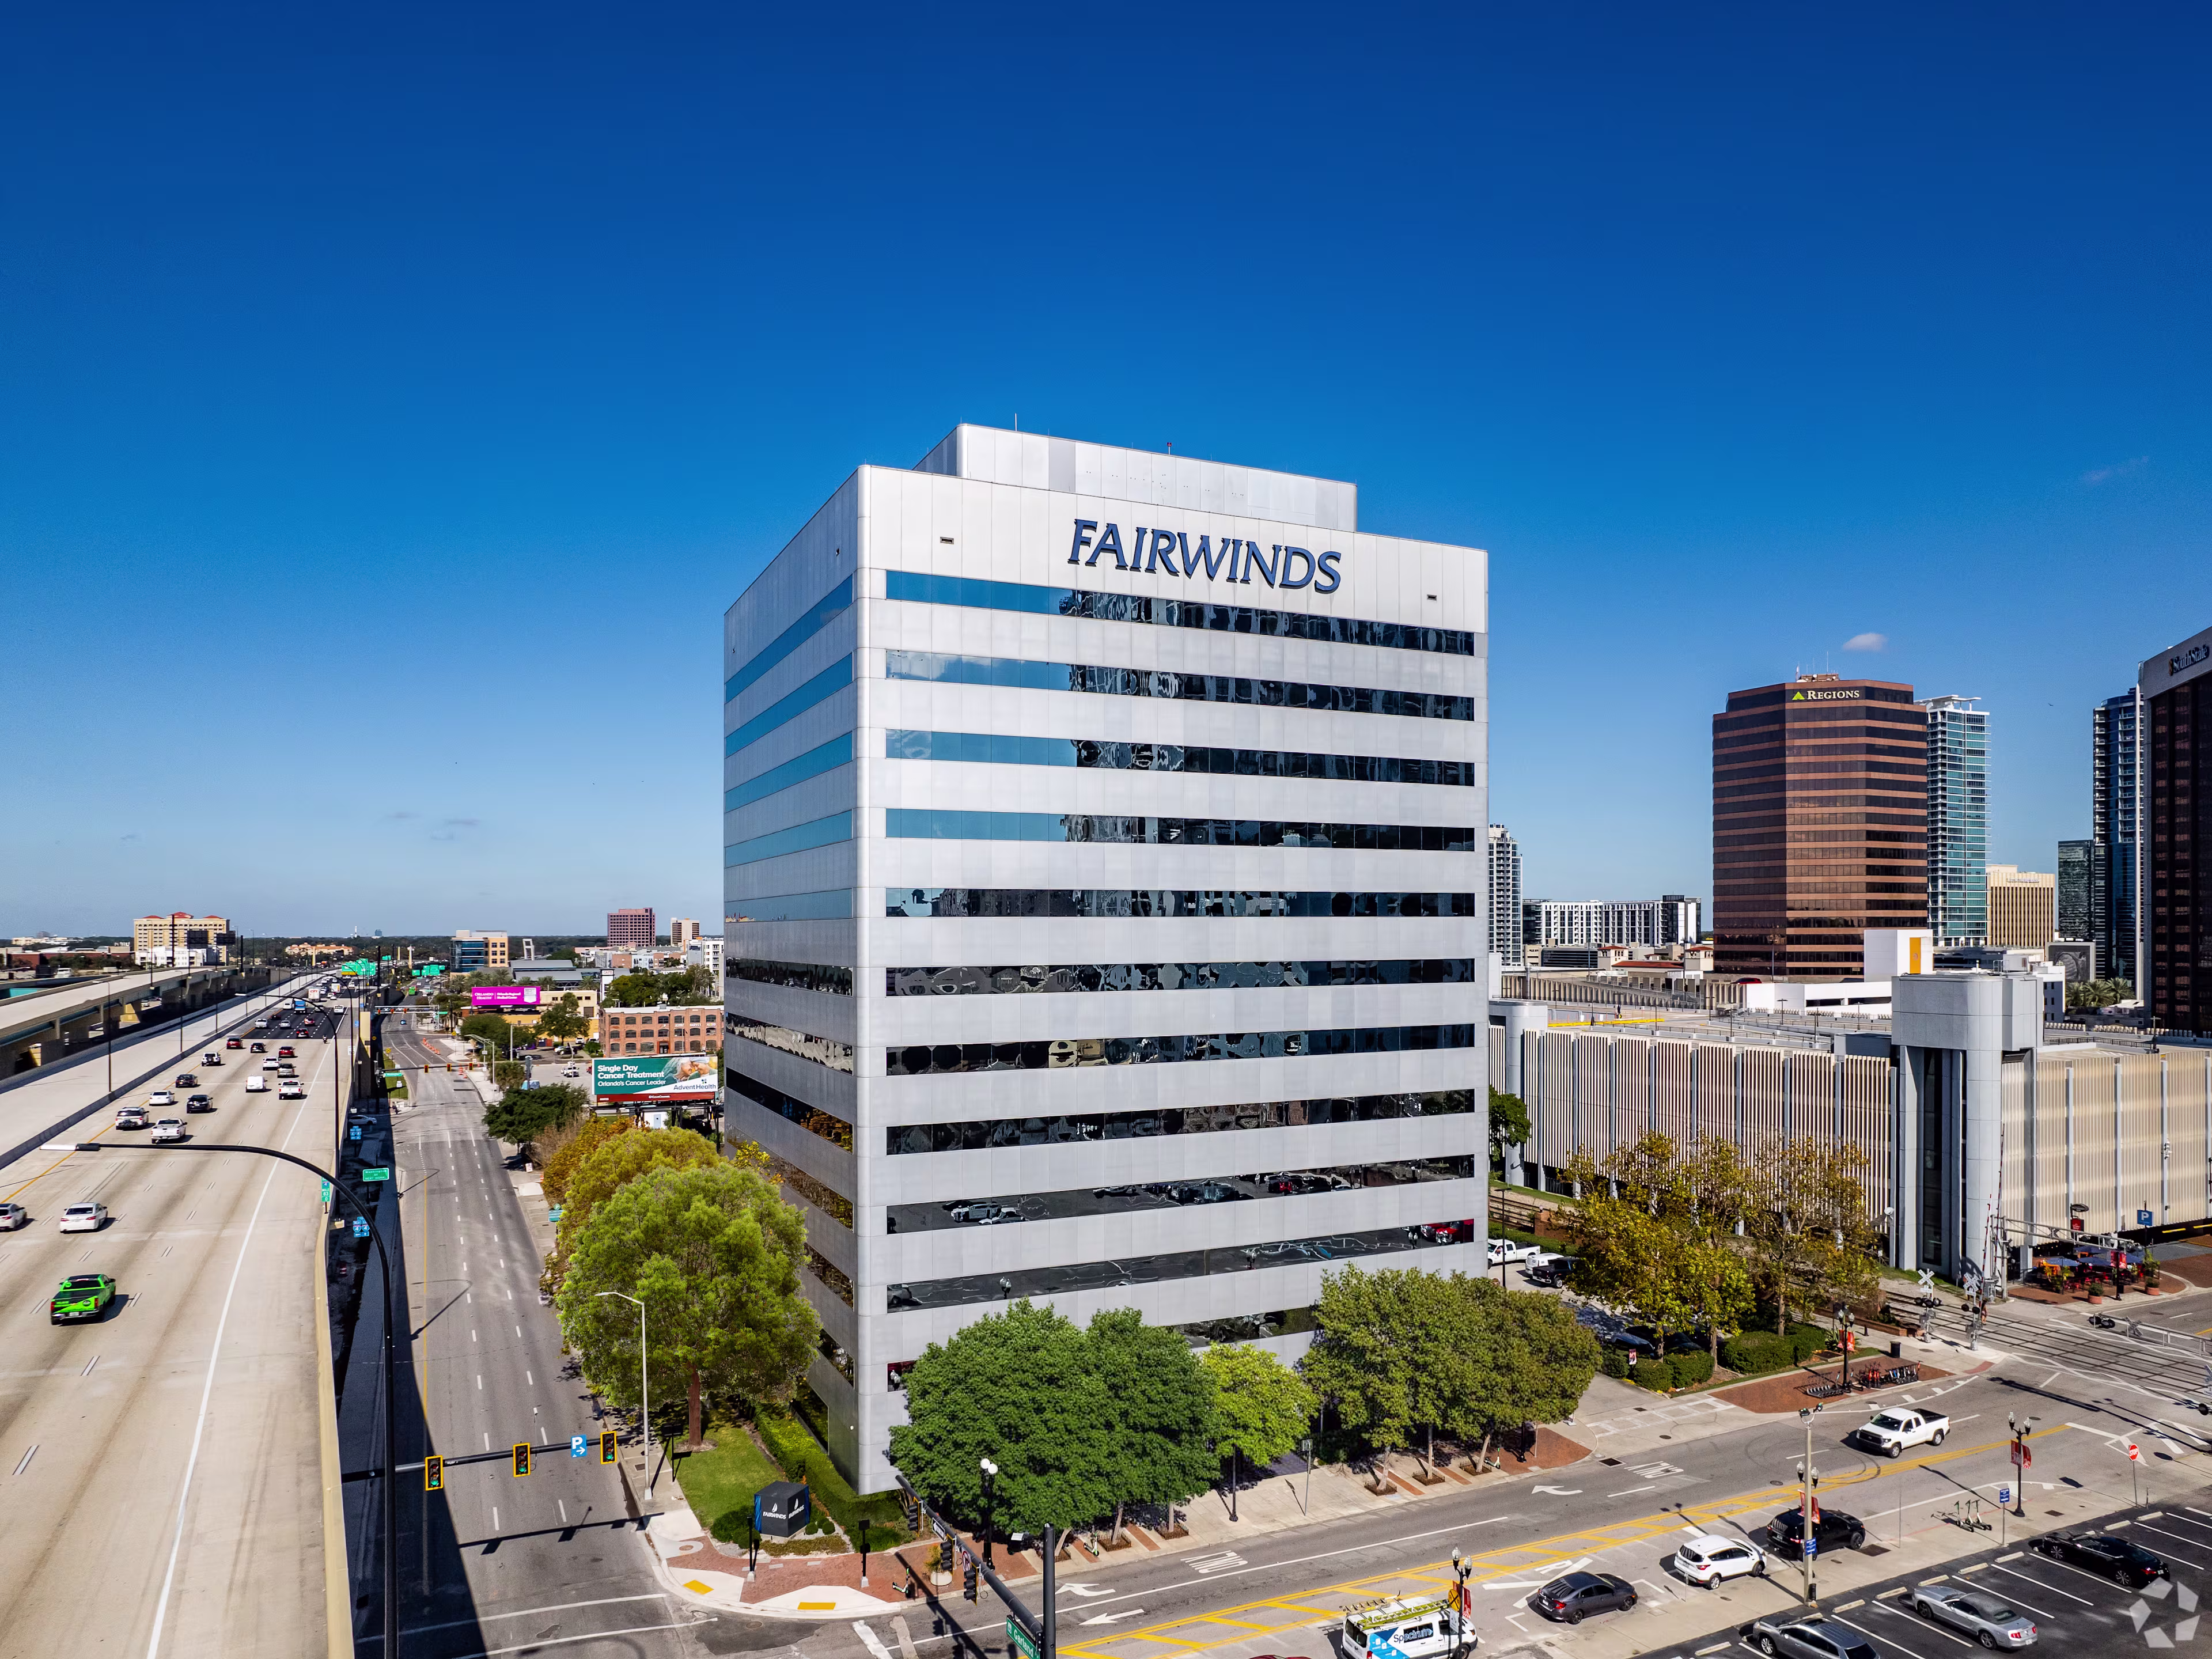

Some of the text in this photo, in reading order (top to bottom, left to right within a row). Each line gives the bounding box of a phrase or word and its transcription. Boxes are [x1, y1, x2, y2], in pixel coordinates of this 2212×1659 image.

[1067, 518, 1341, 594] FAIRWINDS
[2173, 646, 2207, 673] SouthState
[1807, 691, 1859, 700] REGIONS
[2141, 1212, 2149, 1221] P
[571, 1437, 583, 1449] P
[2129, 1448, 2138, 1457] STOP
[763, 1511, 786, 1520] FAIRWINDS
[1393, 1628, 1431, 1643] Spectrum
[1014, 1629, 1034, 1658] Garland
